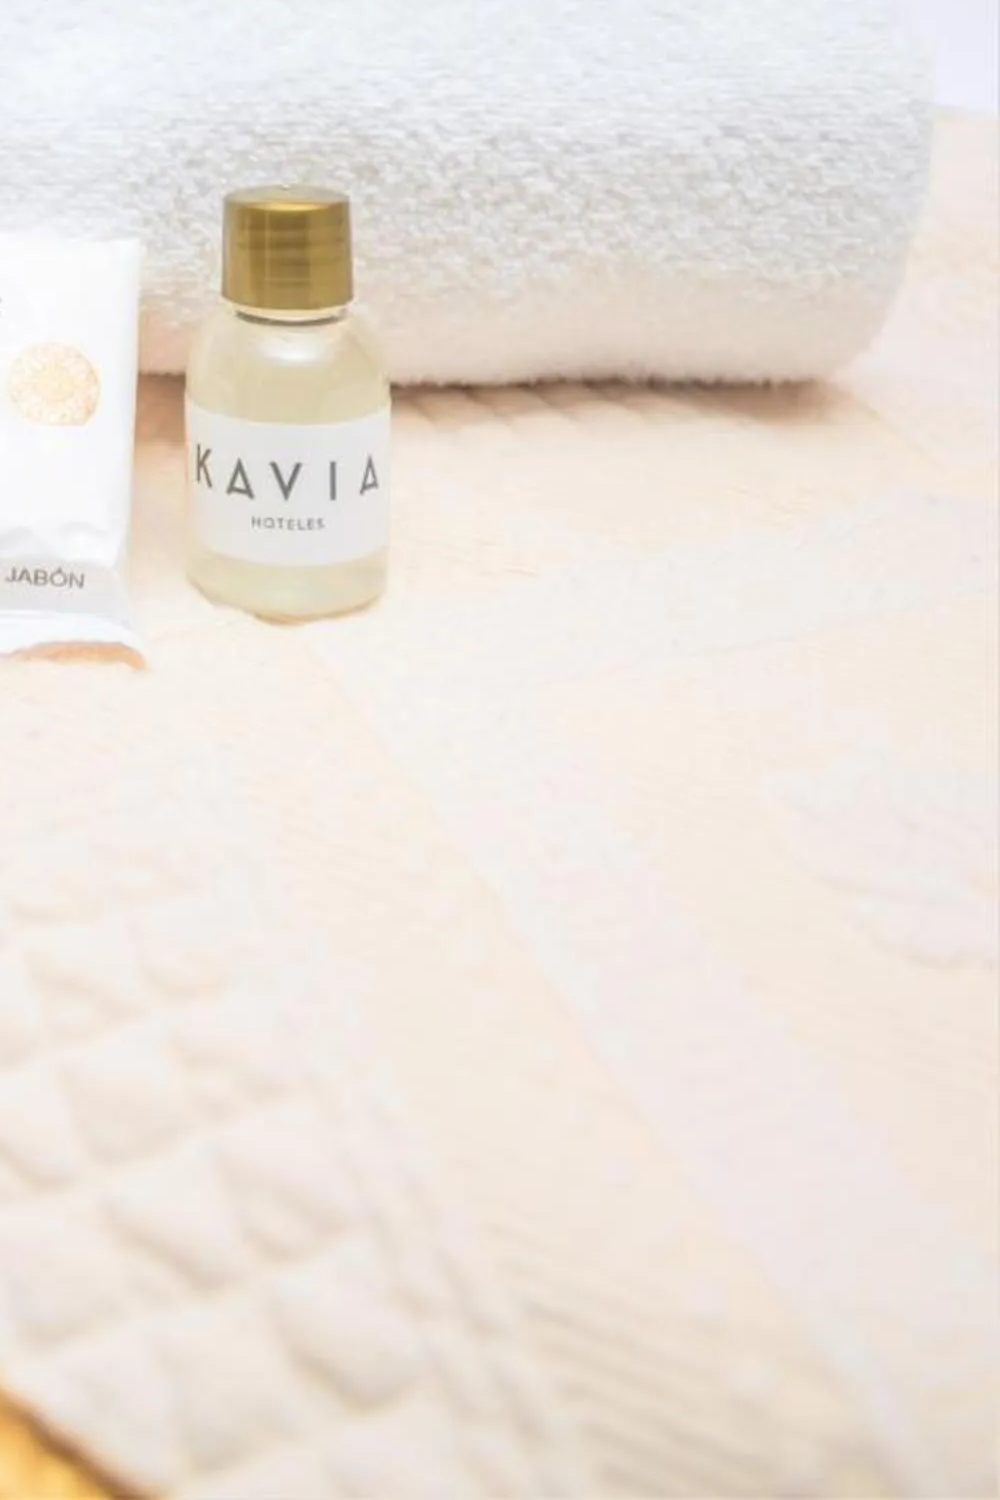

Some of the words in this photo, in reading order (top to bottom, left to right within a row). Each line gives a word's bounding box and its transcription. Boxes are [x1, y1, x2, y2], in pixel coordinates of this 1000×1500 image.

[195, 443, 379, 502] KAVIA
[251, 515, 325, 531] HOTELES
[4, 567, 86, 589] JABÓN
